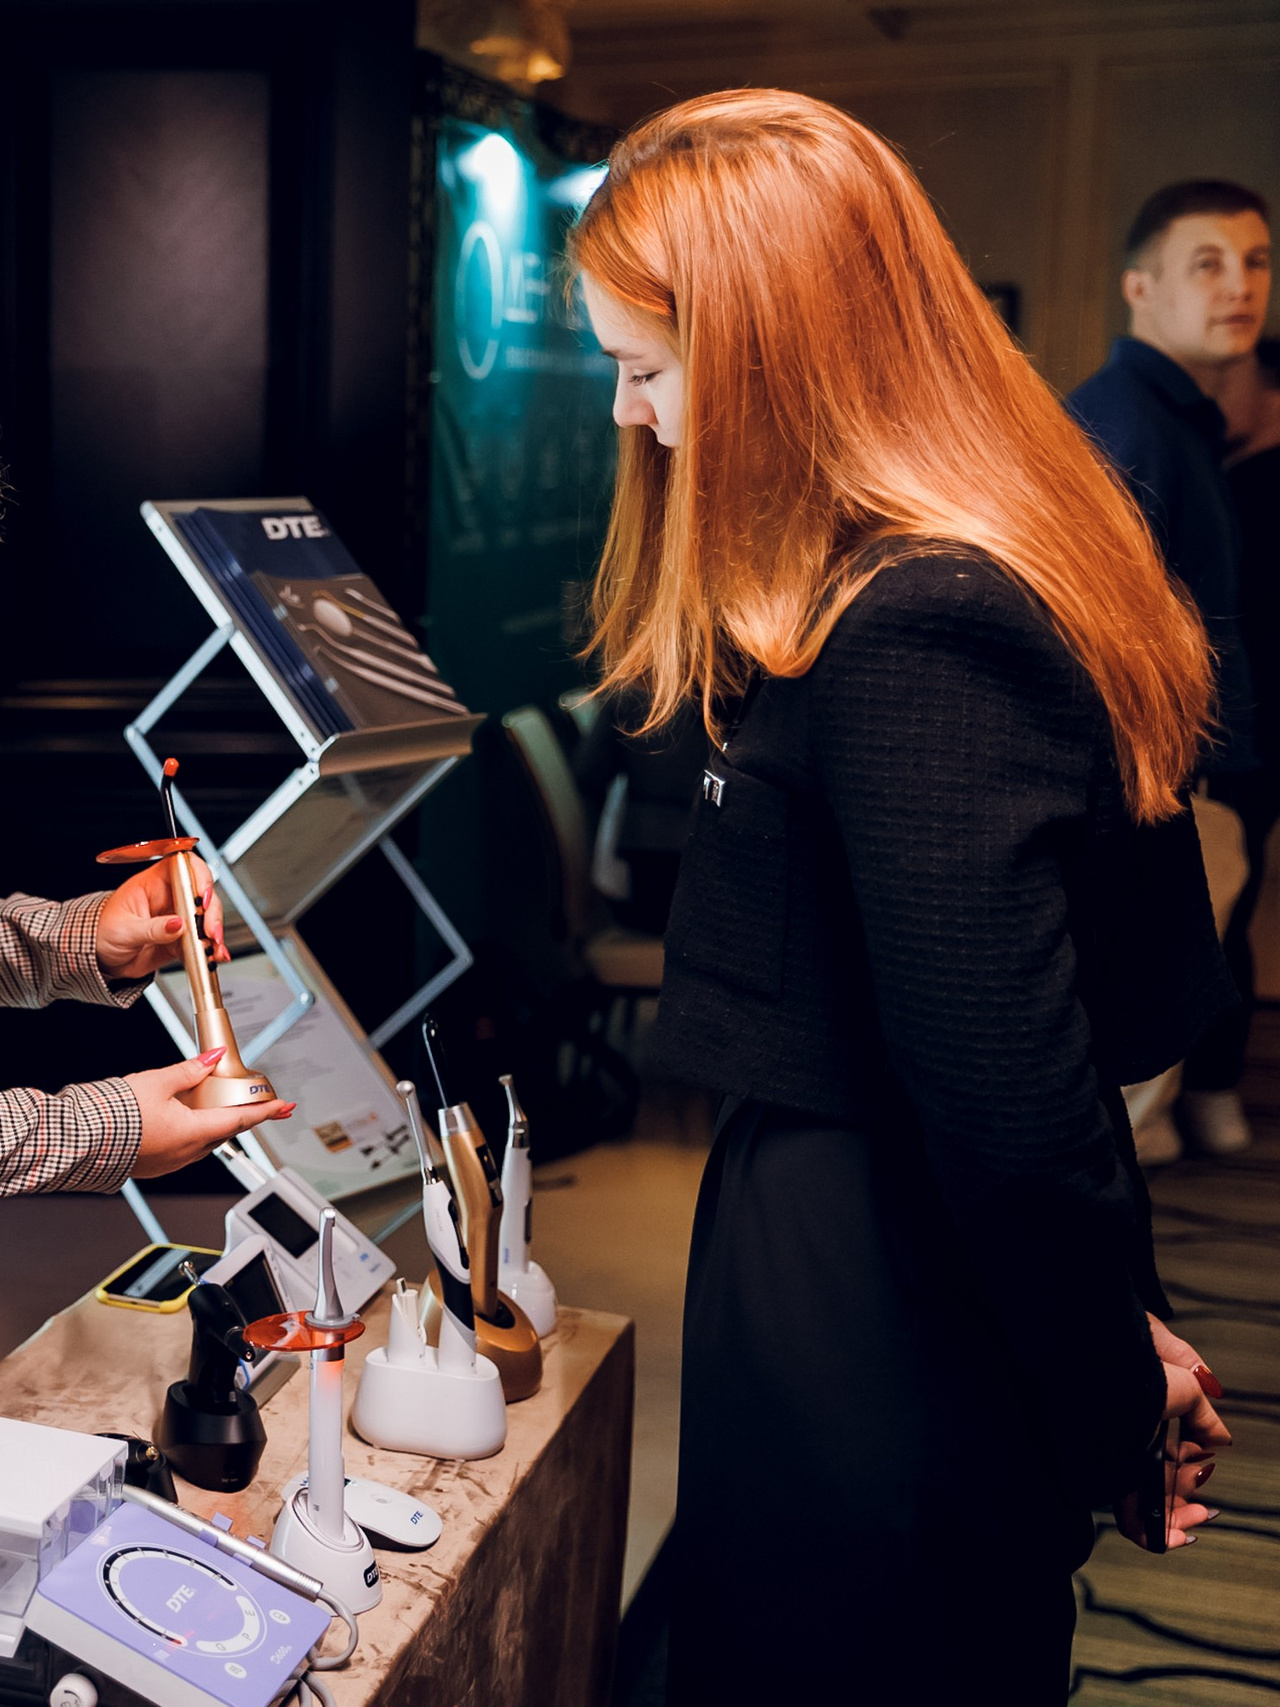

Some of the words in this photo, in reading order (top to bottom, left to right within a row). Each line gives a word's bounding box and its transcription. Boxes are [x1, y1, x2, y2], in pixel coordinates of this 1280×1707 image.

[261, 515, 325, 540] DTE
[410, 1510, 424, 1525] DTE
[166, 1584, 195, 1613] DTE
